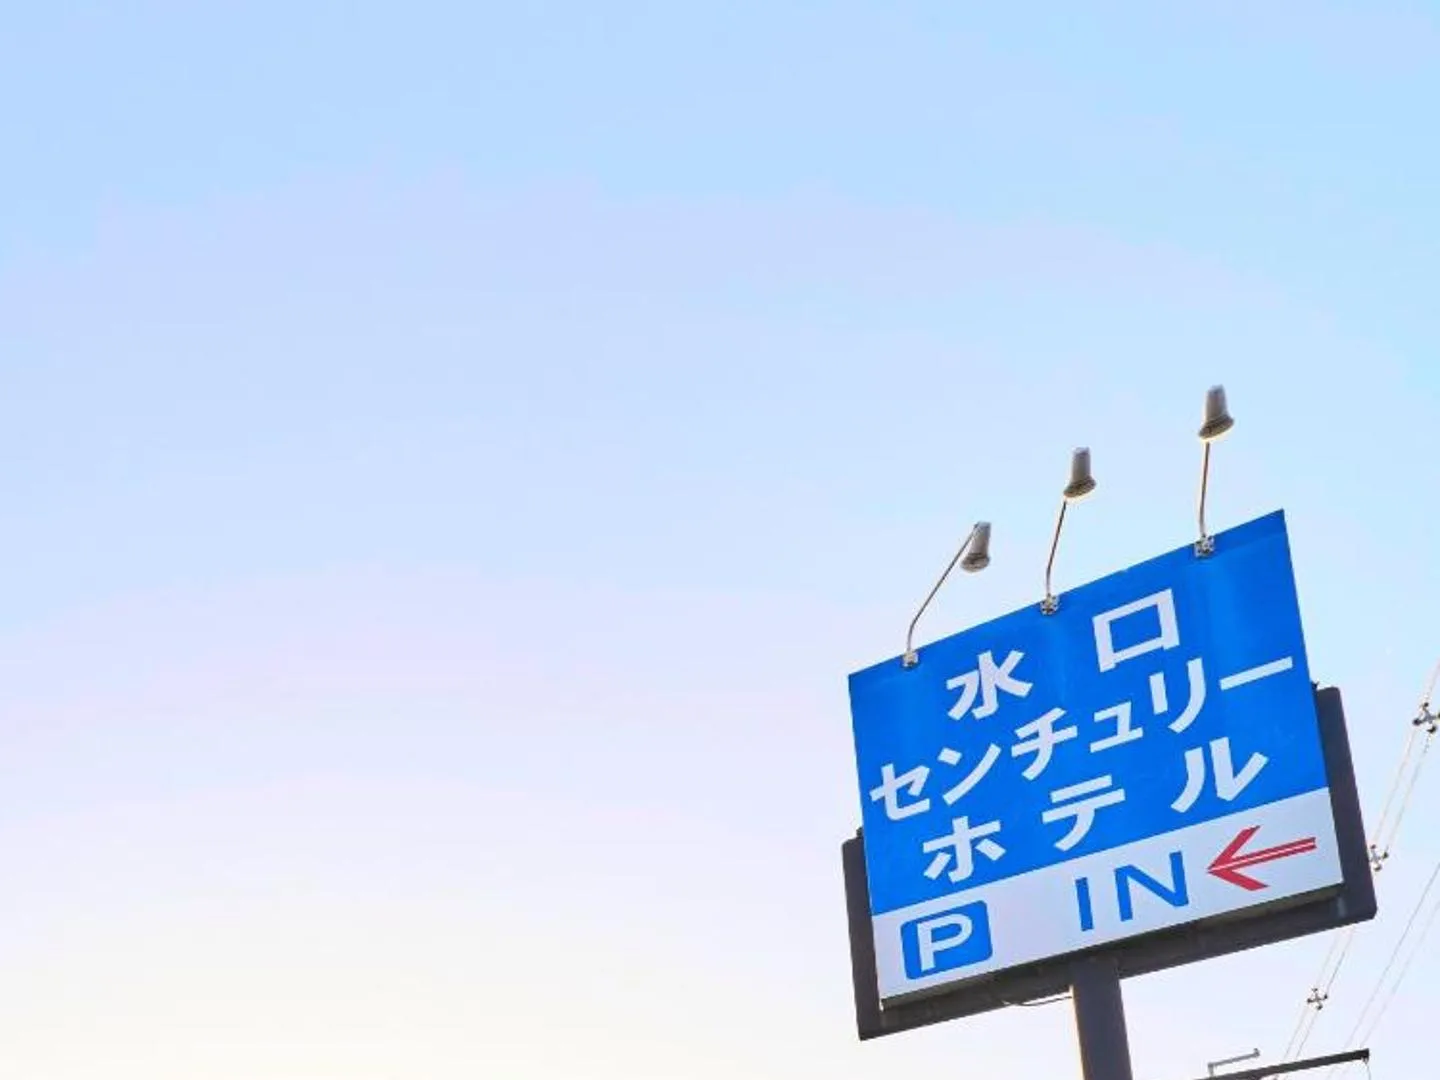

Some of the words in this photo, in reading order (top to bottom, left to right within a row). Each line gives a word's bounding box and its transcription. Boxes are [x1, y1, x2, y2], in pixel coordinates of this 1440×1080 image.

[946, 588, 1181, 722] 水口
[870, 656, 1294, 821] センチュリー
[922, 735, 1270, 884] ホテル
[916, 908, 972, 972] P
[1073, 851, 1191, 932] IN
